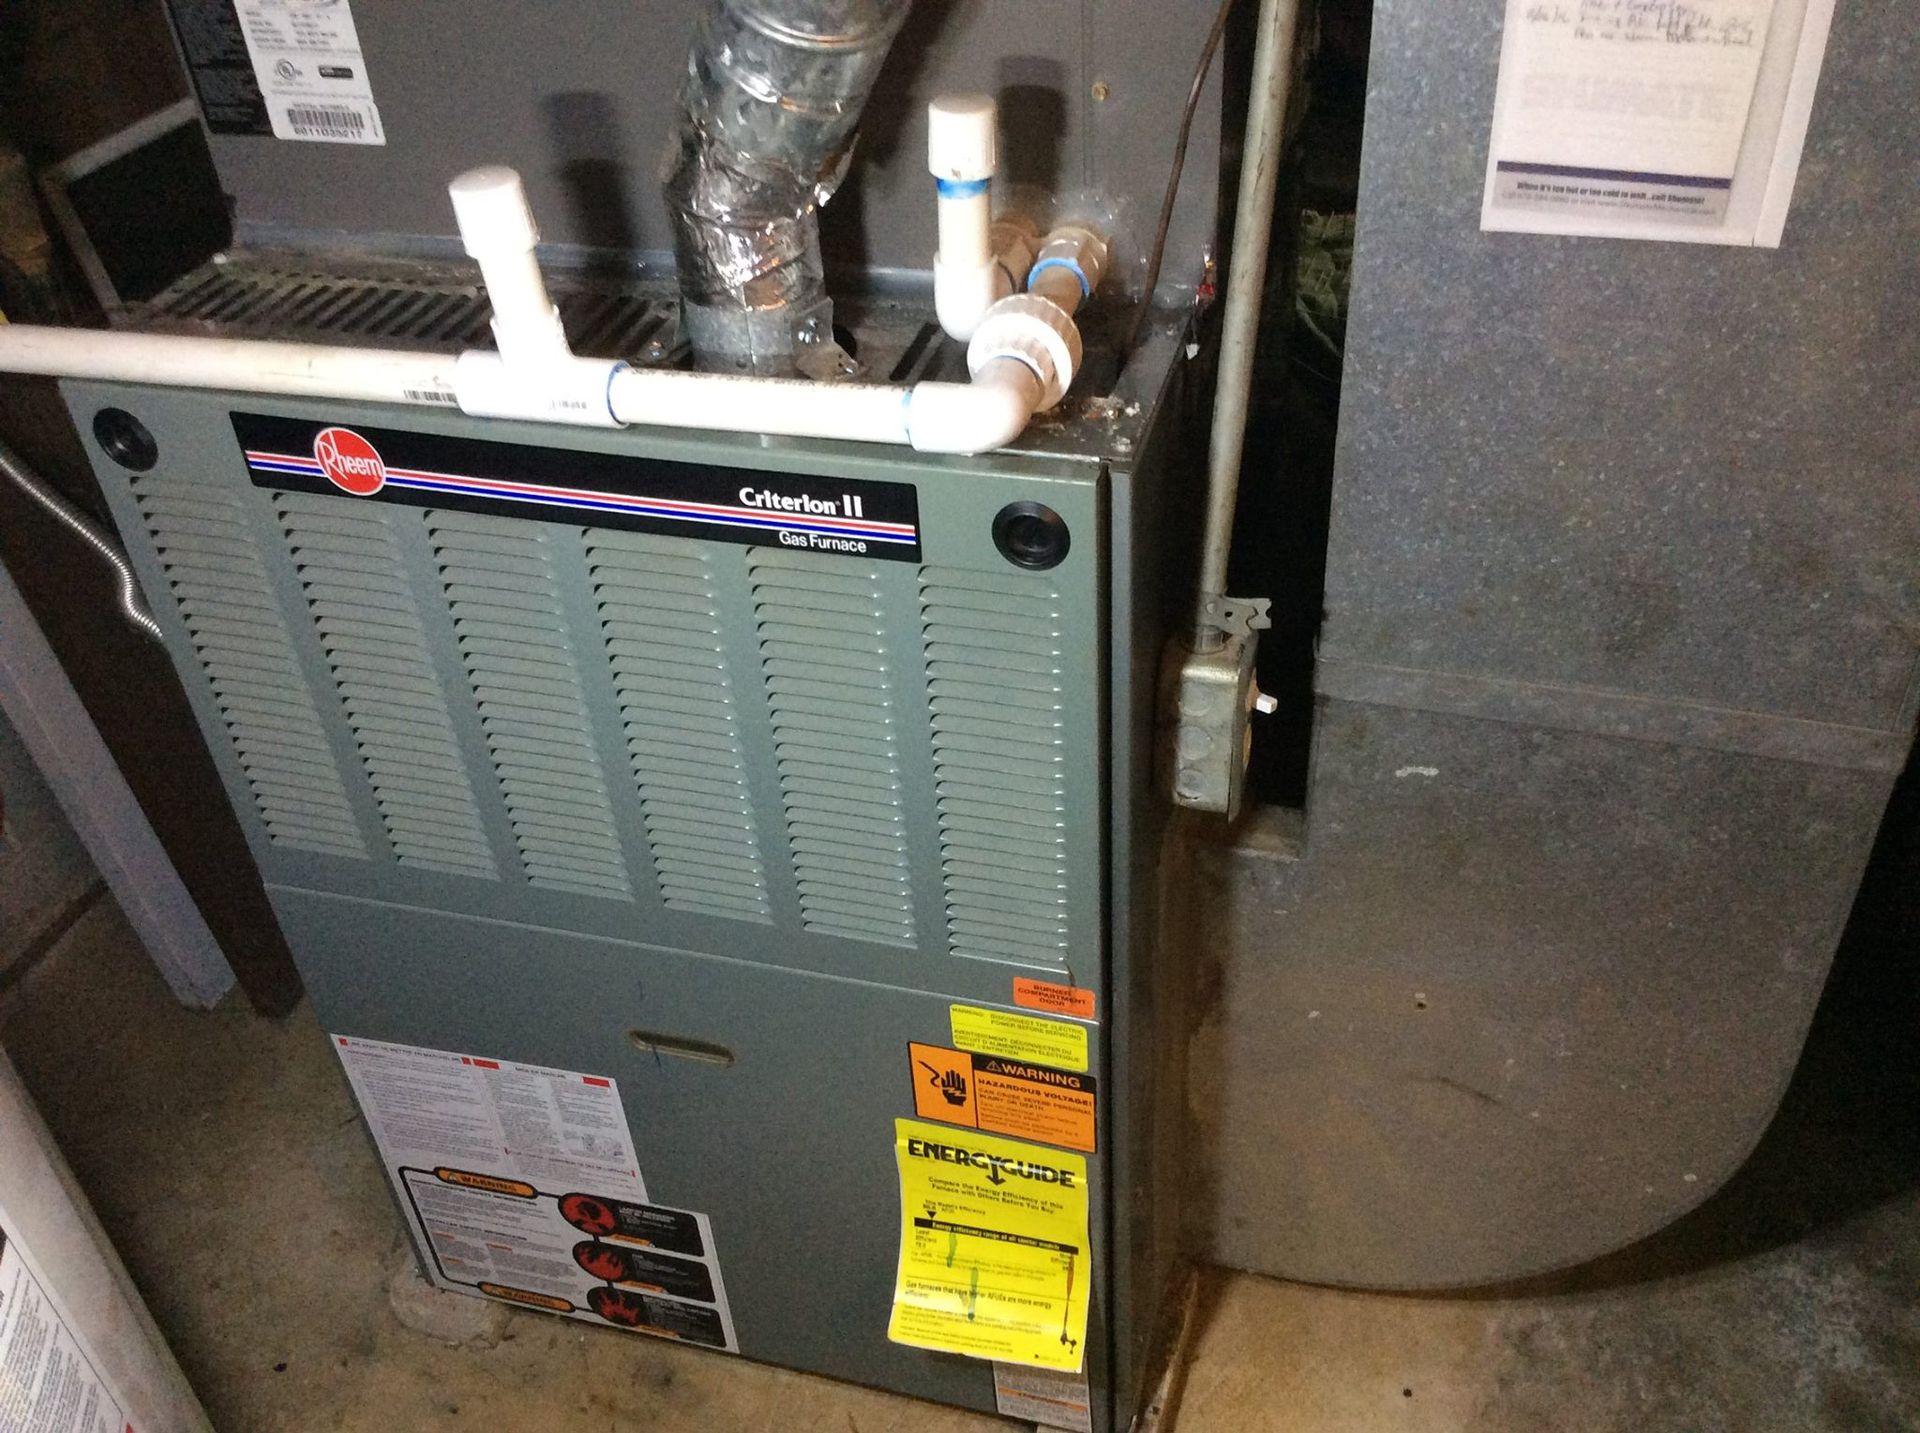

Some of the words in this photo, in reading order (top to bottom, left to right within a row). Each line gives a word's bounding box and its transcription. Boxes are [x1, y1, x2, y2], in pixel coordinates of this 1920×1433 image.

[319, 430, 383, 480] Rheem
[739, 487, 836, 515] Criterion
[843, 494, 864, 517] II
[779, 530, 807, 546] Gas
[809, 533, 867, 553] Furnace
[1018, 987, 1086, 1005] COMPARTMENT
[1002, 1063, 1080, 1088] WARNING
[978, 1078, 1041, 1096] HAZARDOUS
[1043, 1091, 1092, 1107] VOLTAGE!
[908, 1138, 1076, 1188] ENERGYGUIDE
[928, 1176, 960, 1187] Compare
[976, 1185, 1000, 1197] Energy
[1002, 1191, 1038, 1205] Efficiency
